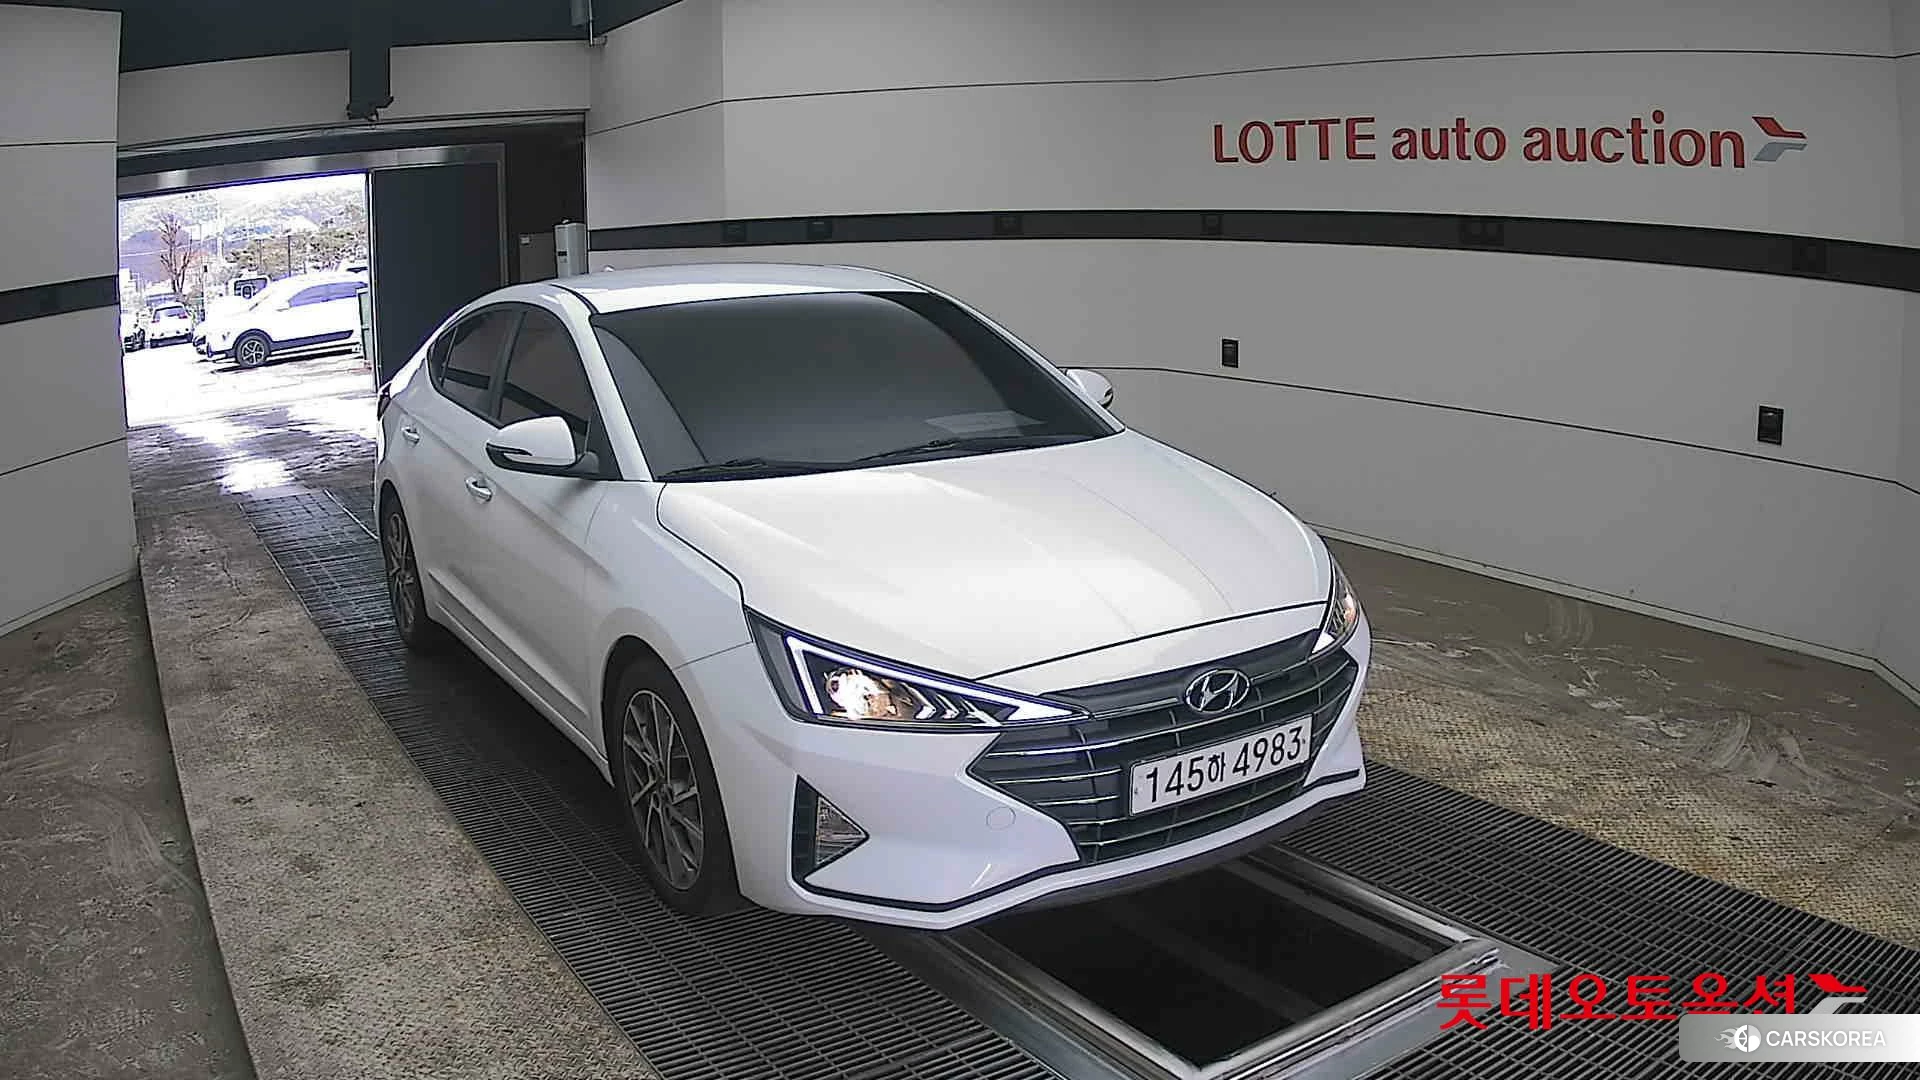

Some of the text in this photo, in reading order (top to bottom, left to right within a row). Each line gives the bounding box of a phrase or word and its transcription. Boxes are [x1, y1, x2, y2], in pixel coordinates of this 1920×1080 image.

[1213, 109, 1746, 169] LOTTE auto auction
[1232, 725, 1303, 777] 4983
